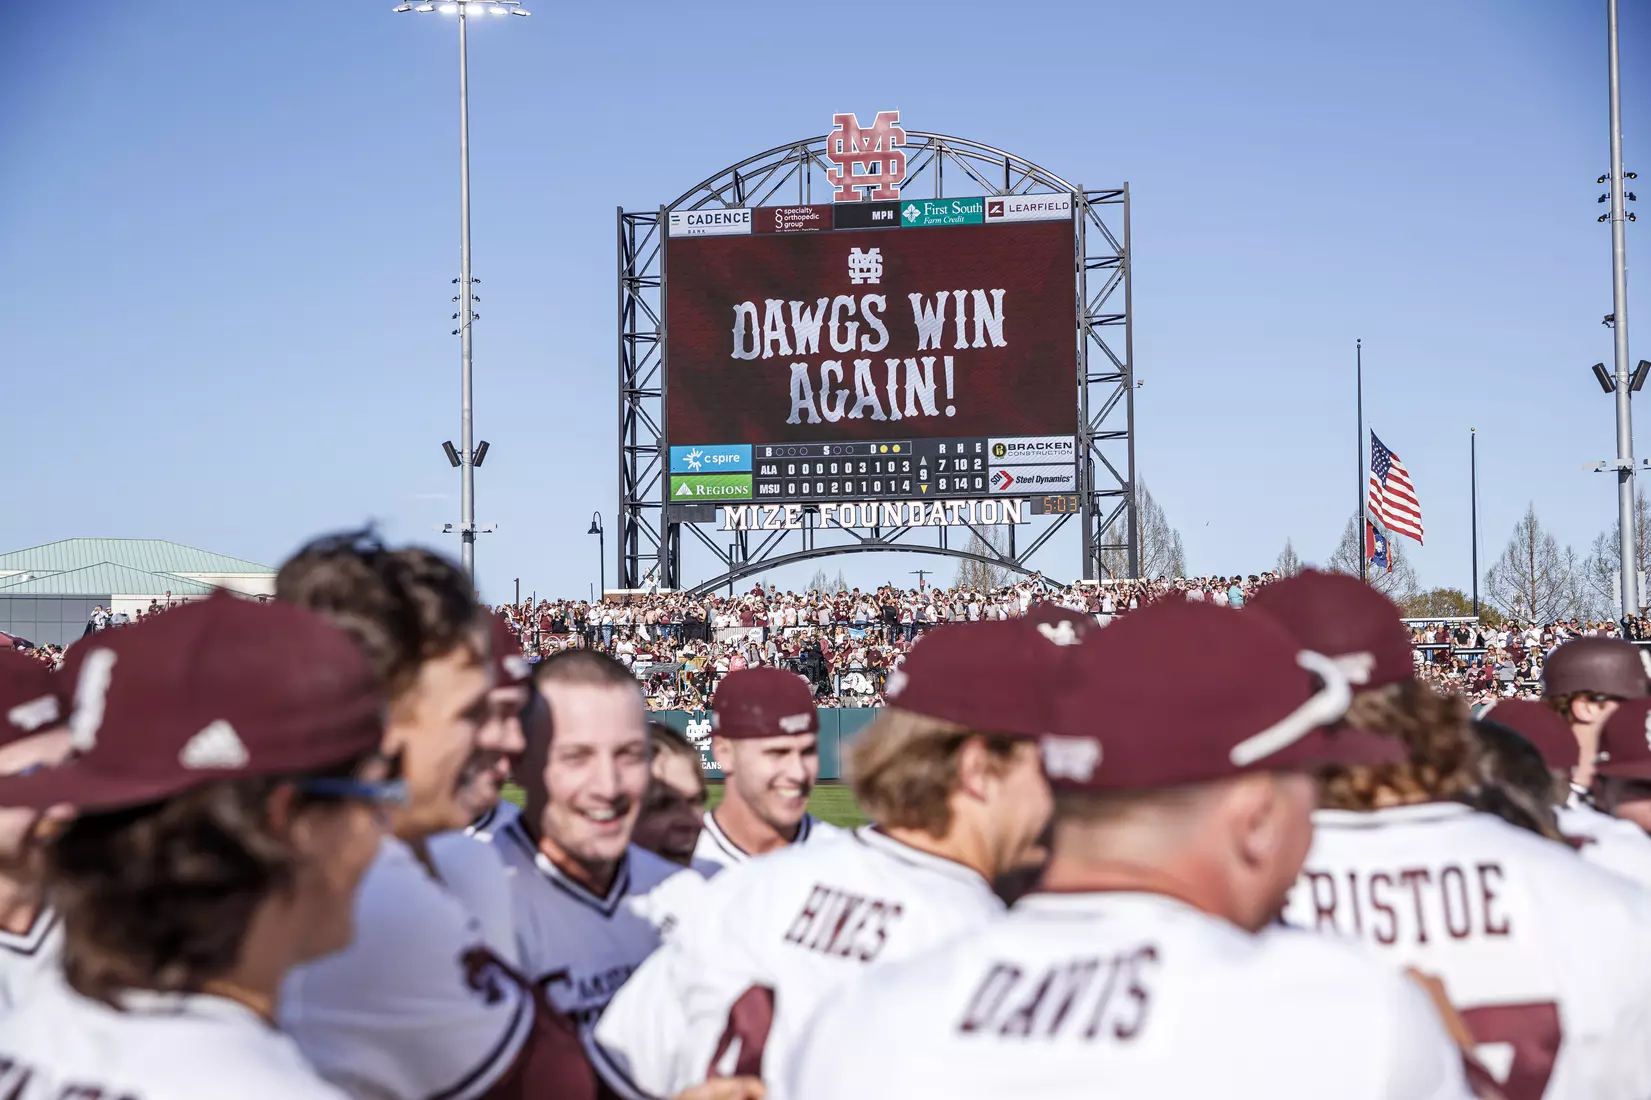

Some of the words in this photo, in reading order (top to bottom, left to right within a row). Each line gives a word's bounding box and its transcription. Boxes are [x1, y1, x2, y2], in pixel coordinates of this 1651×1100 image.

[924, 202, 948, 216] First
[952, 201, 982, 214] South
[1009, 202, 1069, 212] LEARFIELD
[687, 212, 750, 225] CADENCE
[784, 213, 820, 221] orthopedic
[872, 210, 893, 220] MPH
[784, 221, 804, 229] group
[731, 294, 890, 360] DAWGS
[908, 289, 1008, 350] WIN
[786, 356, 956, 424] AGAIN!
[765, 447, 772, 456] B
[824, 446, 830, 455] S
[939, 444, 945, 453] R
[957, 444, 963, 453] H
[976, 443, 981, 452] E
[1008, 442, 1072, 451] BRACKEN
[712, 454, 740, 465] spire
[939, 459, 946, 470] 7
[954, 459, 968, 470] 10
[974, 458, 981, 470] 2
[761, 465, 777, 475] ALA
[788, 464, 795, 475] 0
[802, 464, 809, 474] 0
[817, 463, 823, 474] 0
[831, 463, 837, 473] 0
[845, 463, 852, 473] 0
[859, 462, 866, 473] 3
[875, 462, 880, 472] 1
[888, 461, 895, 472] 0
[902, 461, 910, 472] 3
[920, 469, 927, 480] 9
[990, 472, 1002, 486] SDI
[1016, 476, 1034, 484] Steel
[760, 484, 780, 494] MSU
[788, 483, 795, 494] 0
[802, 483, 809, 493] 0
[817, 483, 823, 493] 0
[831, 482, 838, 493] 2
[845, 482, 852, 492] 0
[861, 481, 866, 492] 1
[874, 481, 881, 492] 0
[890, 481, 895, 491] 1
[902, 480, 910, 491] 4
[939, 478, 946, 489] 8
[954, 478, 968, 489] 14
[975, 477, 982, 488] 0
[696, 485, 749, 495] REGIONS
[1044, 497, 1077, 513] 5:03
[723, 503, 802, 530] MIZE
[818, 499, 1024, 529] FOUNDATION
[1305, 863, 1512, 944] RISTOE
